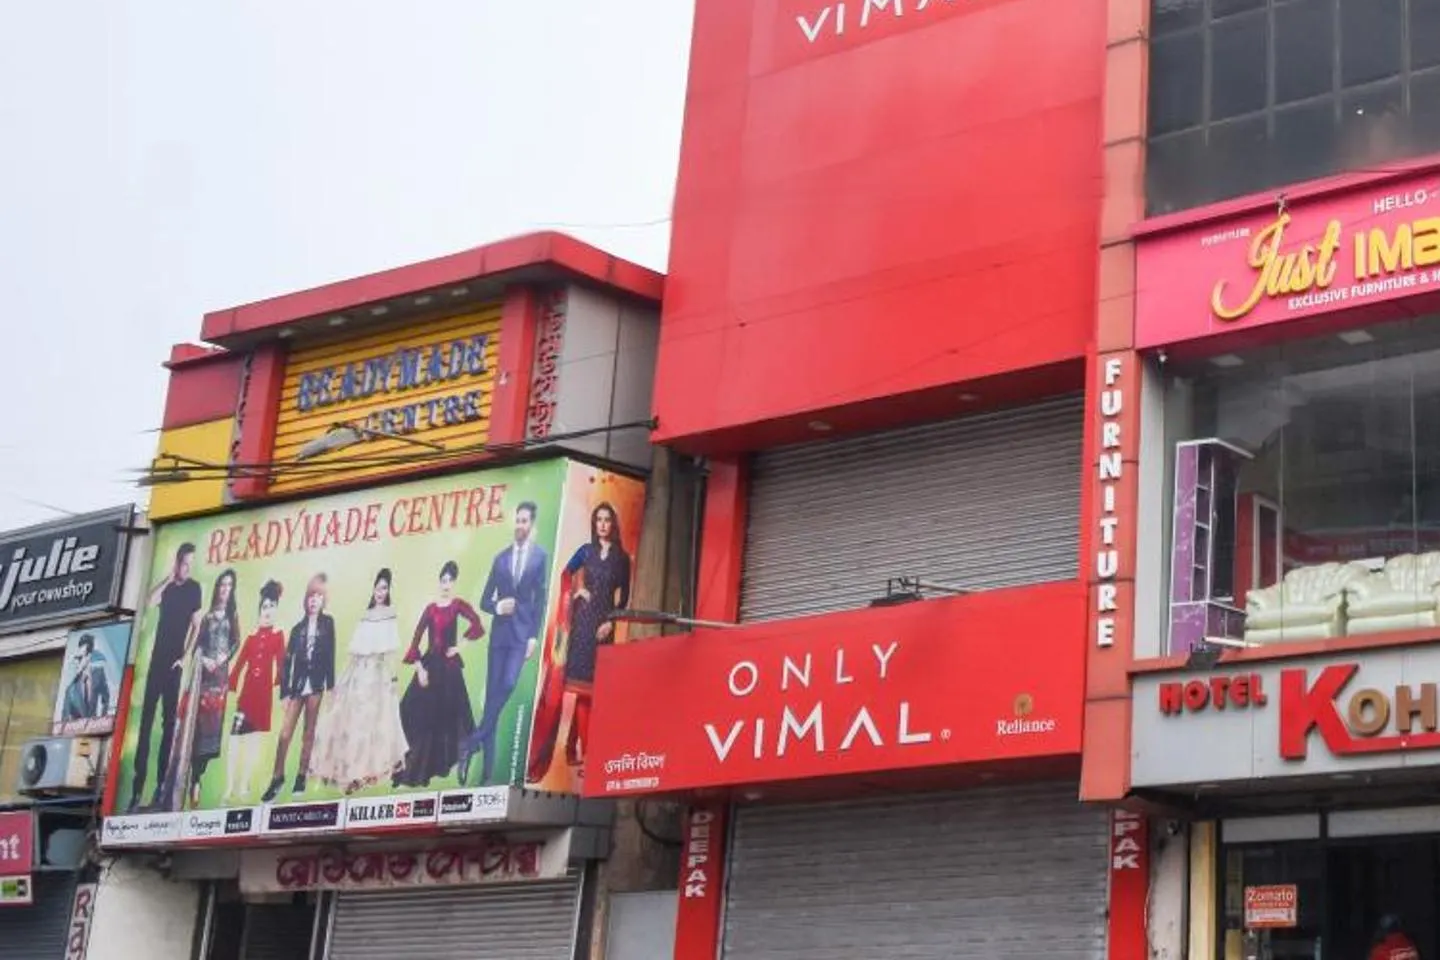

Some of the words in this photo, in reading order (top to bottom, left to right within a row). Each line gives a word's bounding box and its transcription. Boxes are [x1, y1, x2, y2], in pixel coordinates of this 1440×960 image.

[1374, 189, 1427, 214] HELLO
[1211, 213, 1341, 320] Just
[1288, 287, 1349, 310] EXCLUSIVE
[1351, 274, 1416, 298] FURNITURE
[296, 334, 488, 412] READYMADE
[364, 390, 483, 436] CENTRE
[389, 484, 508, 538] CENTRE
[1097, 359, 1123, 647] FURNITURE
[729, 642, 898, 696] ONLY
[1159, 673, 1267, 715] HOTEL
[704, 700, 932, 763] VIMAL
[996, 719, 1056, 736] Reliance
[349, 804, 394, 821] KILLER
